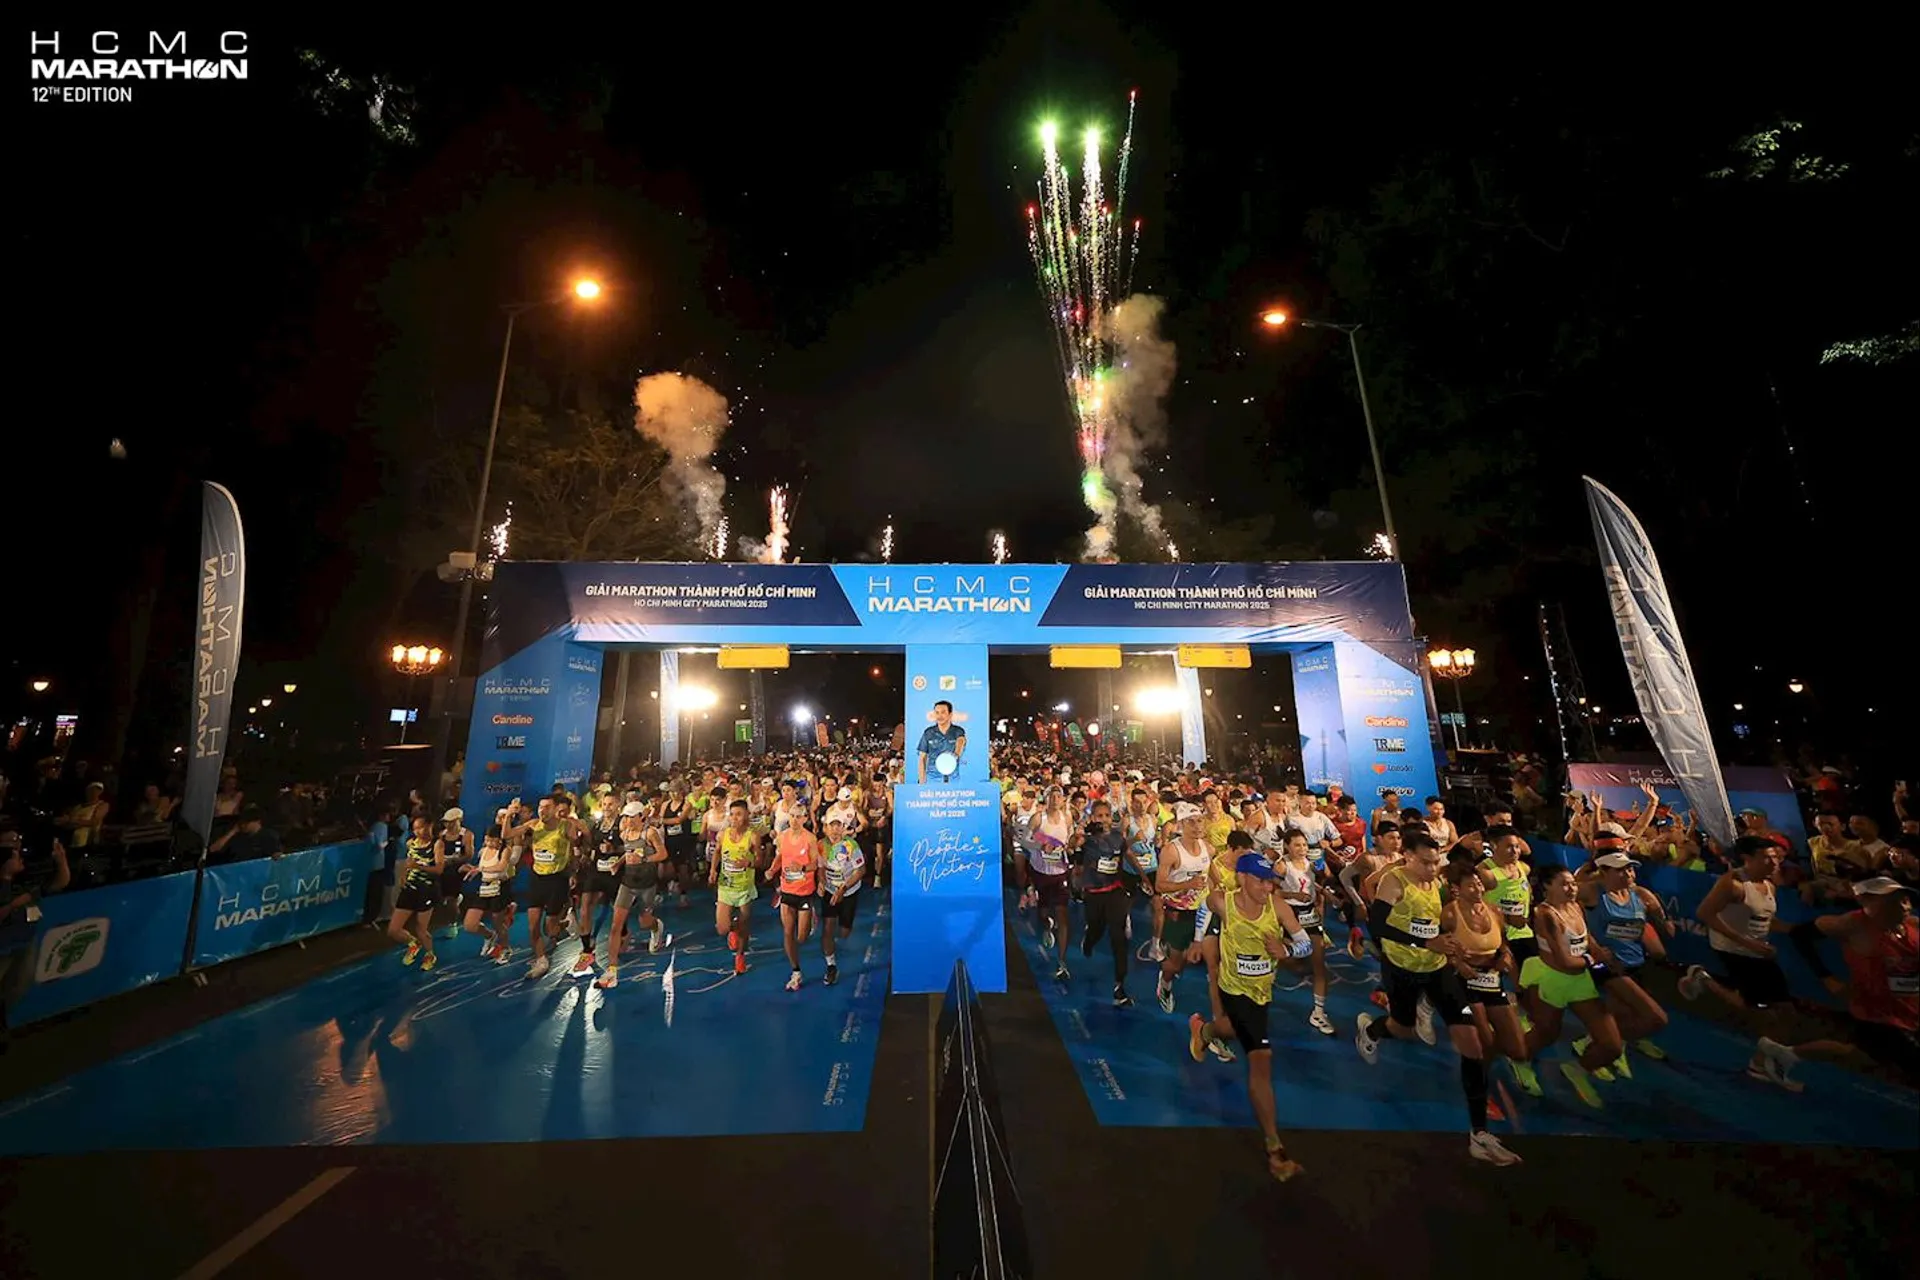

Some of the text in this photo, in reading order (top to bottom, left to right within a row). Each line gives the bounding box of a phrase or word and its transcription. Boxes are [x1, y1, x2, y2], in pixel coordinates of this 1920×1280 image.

[611, 585, 677, 597] MARATHON
[786, 587, 816, 598] MINH
[1109, 587, 1176, 599] MARATHON
[1287, 587, 1317, 599] MINH
[702, 600, 747, 608] MARATHON
[868, 597, 1031, 612] MARATHON
[1203, 601, 1249, 609] MARATHON
[484, 687, 550, 695] MARATHON
[214, 885, 350, 931] MARATHON
